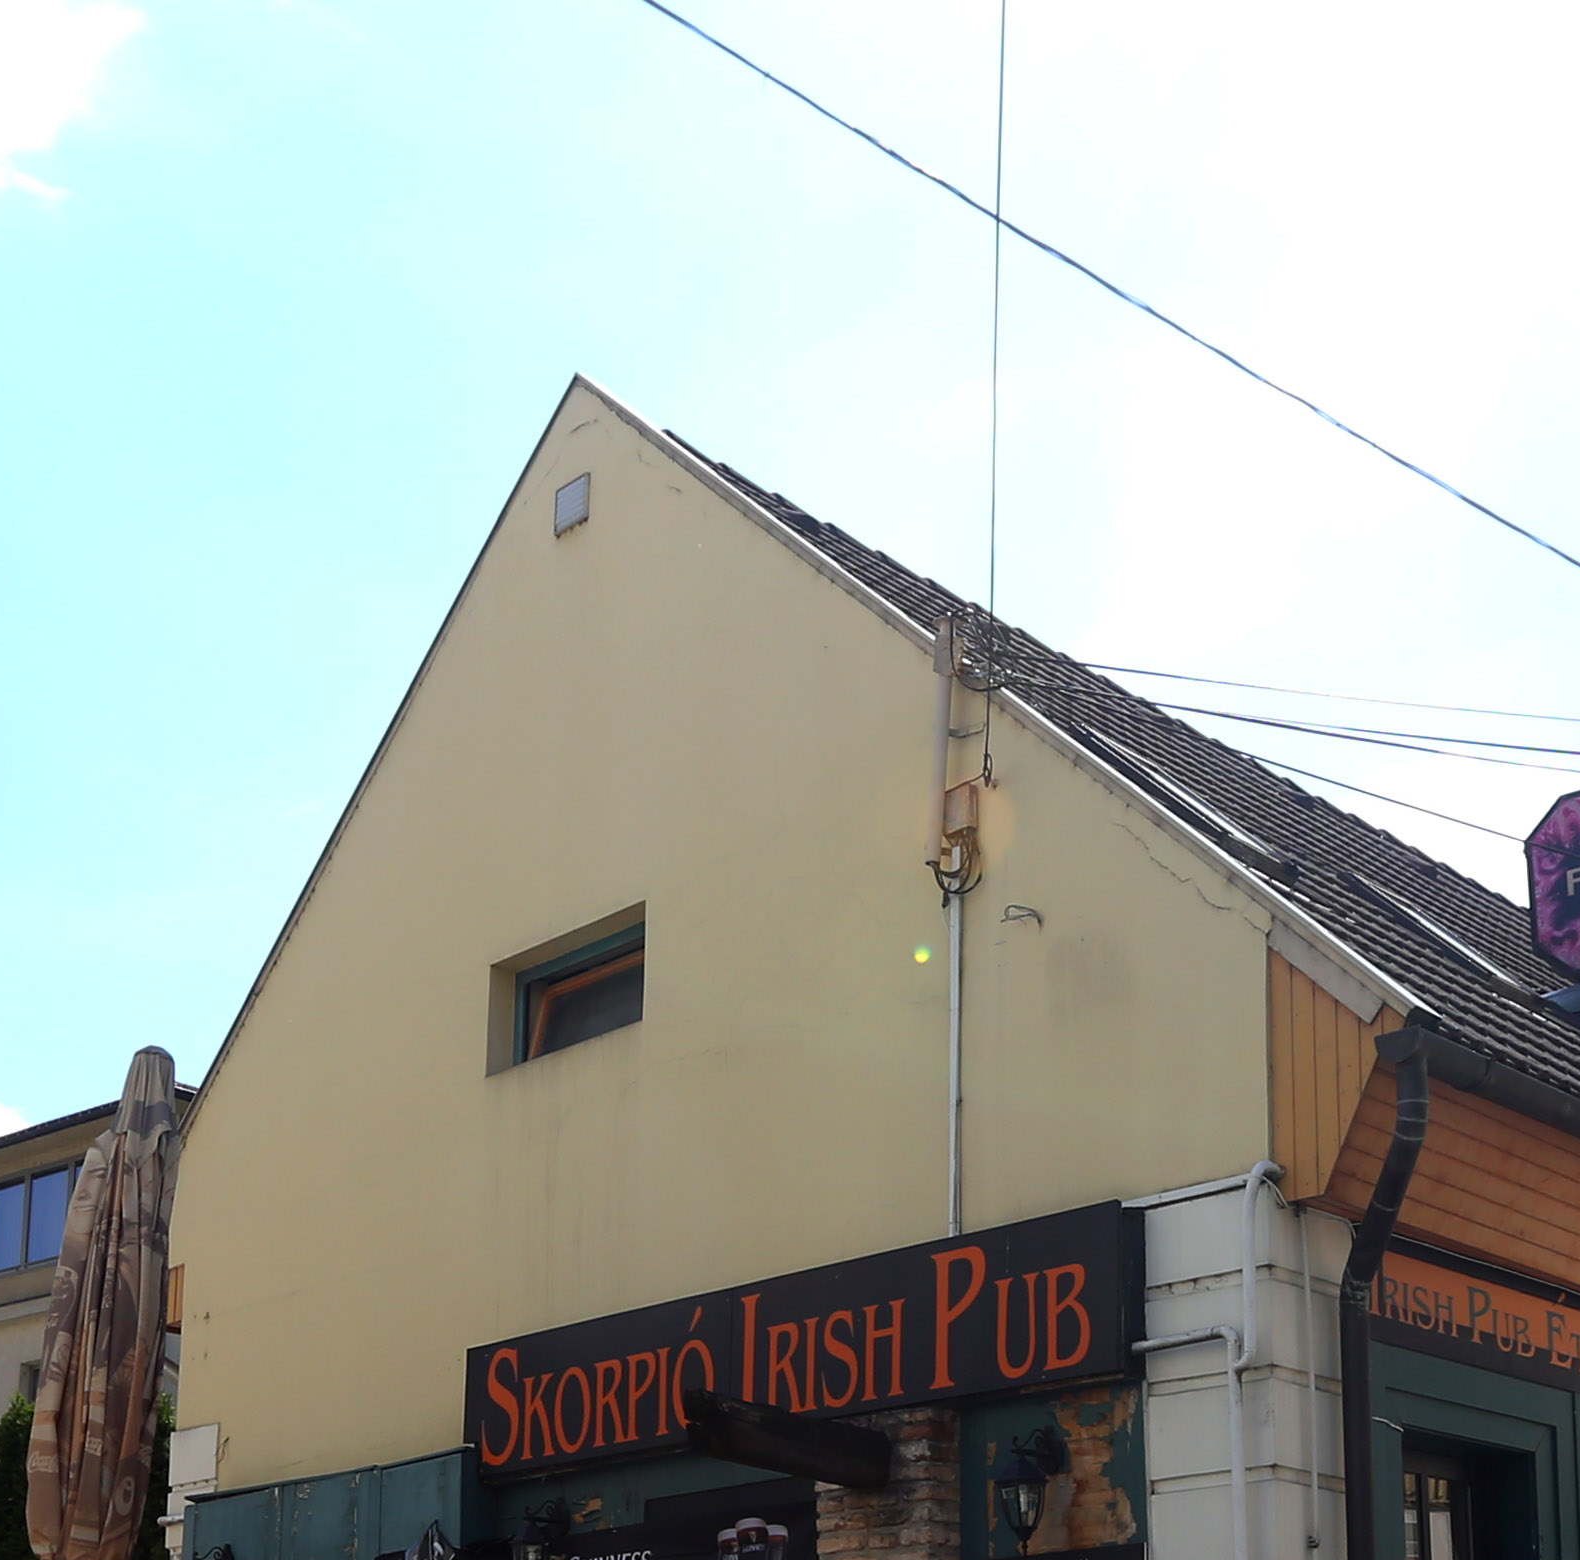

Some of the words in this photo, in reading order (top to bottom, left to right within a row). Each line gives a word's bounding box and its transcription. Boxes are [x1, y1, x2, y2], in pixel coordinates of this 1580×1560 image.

[481, 1306, 715, 1468] SKORPIÓ
[740, 1294, 905, 1415] IRISH
[927, 1246, 1092, 1391] PUB
[1368, 1271, 1461, 1339] IRISH
[1467, 1286, 1537, 1358] PUB
